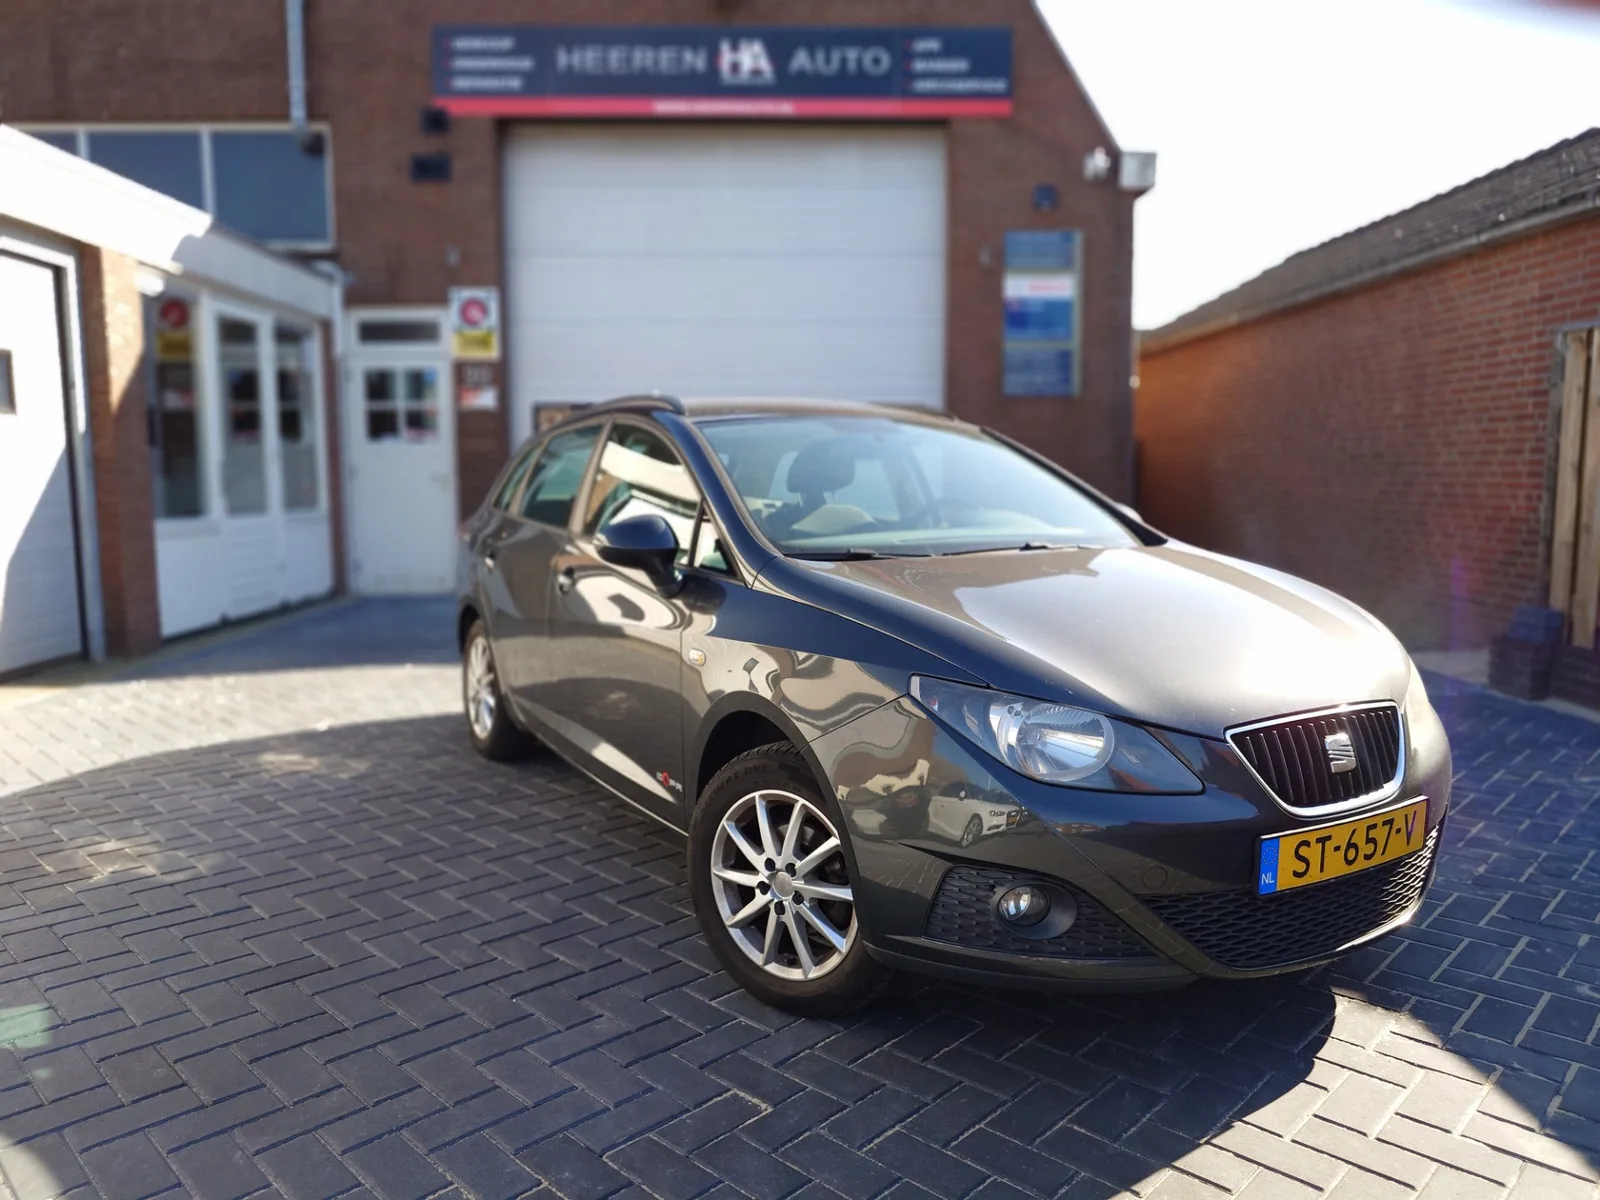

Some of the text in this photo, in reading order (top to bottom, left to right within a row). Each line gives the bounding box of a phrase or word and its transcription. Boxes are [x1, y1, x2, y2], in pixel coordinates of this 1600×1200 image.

[556, 45, 707, 74] HEEREN
[788, 45, 891, 75] AUTO
[1291, 809, 1418, 879] ST-657-V
[1260, 872, 1275, 885] NL
